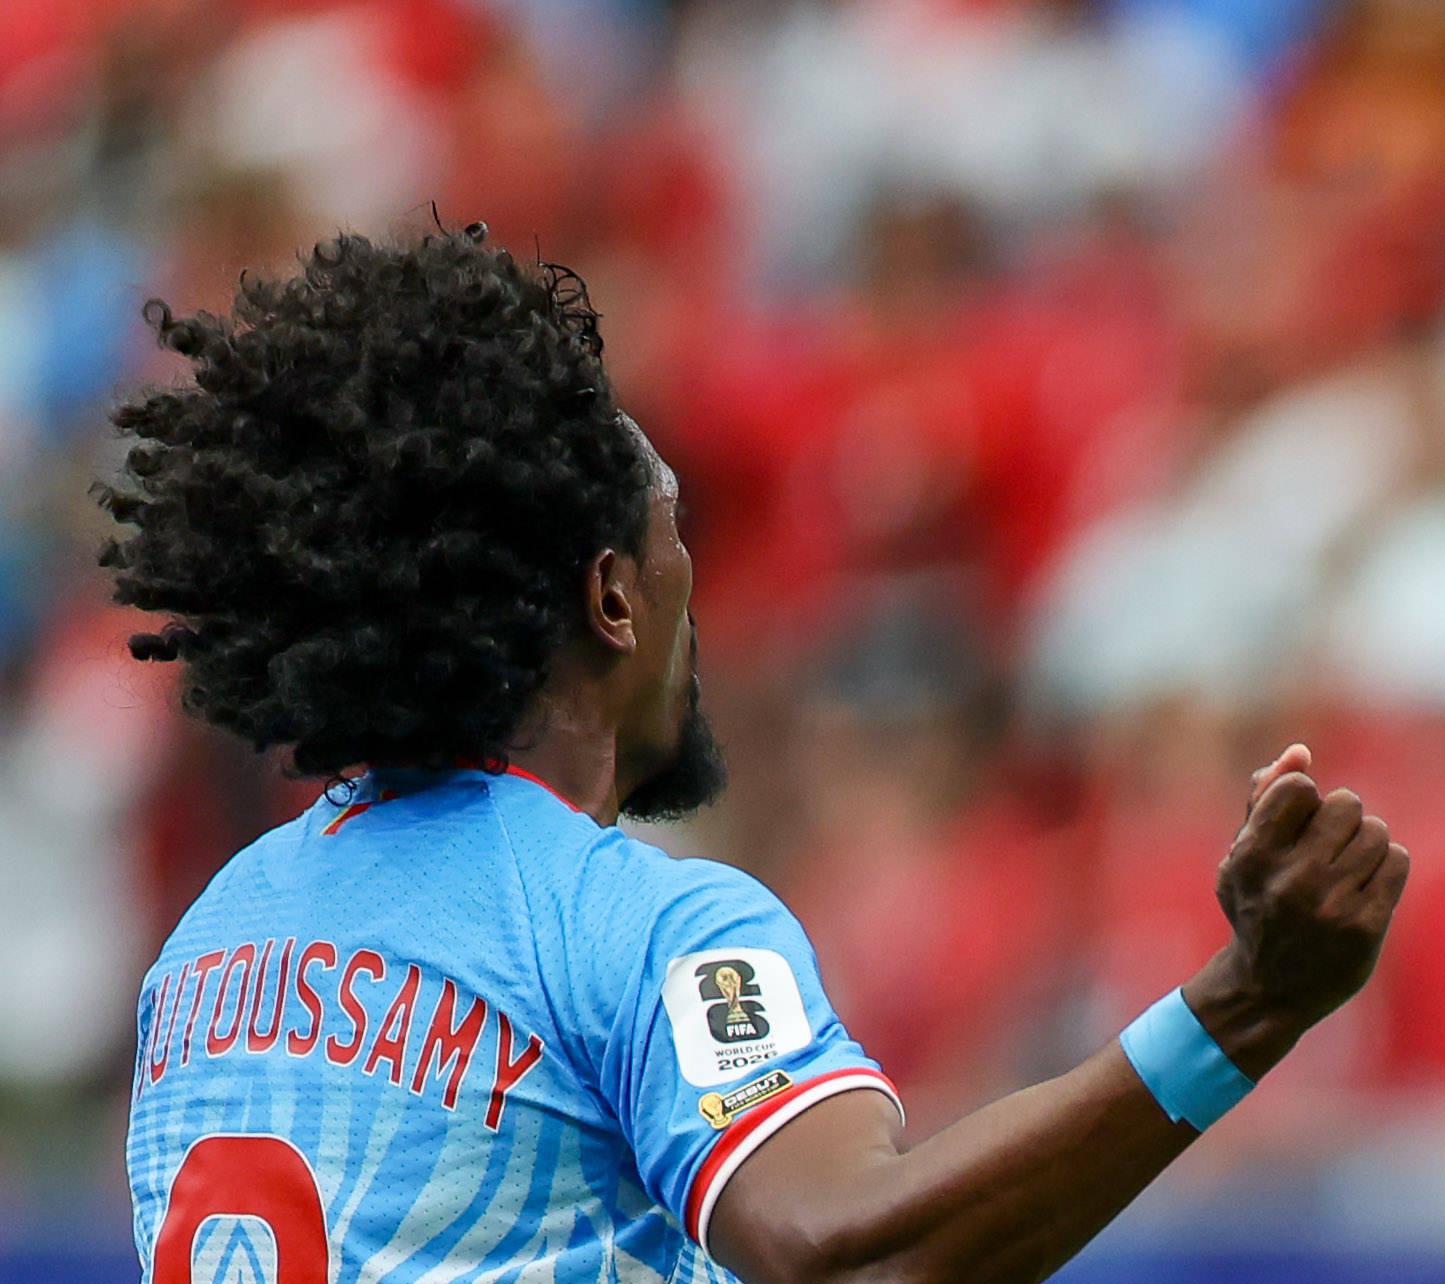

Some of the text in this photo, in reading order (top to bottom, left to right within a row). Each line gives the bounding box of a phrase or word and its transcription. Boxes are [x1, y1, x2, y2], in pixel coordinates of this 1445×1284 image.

[135, 936, 545, 1134] UTOUSSAMY
[726, 1023, 758, 1038] FIFA
[714, 1042, 777, 1057] WORLD CUP
[724, 1074, 779, 1108] DEBUT
